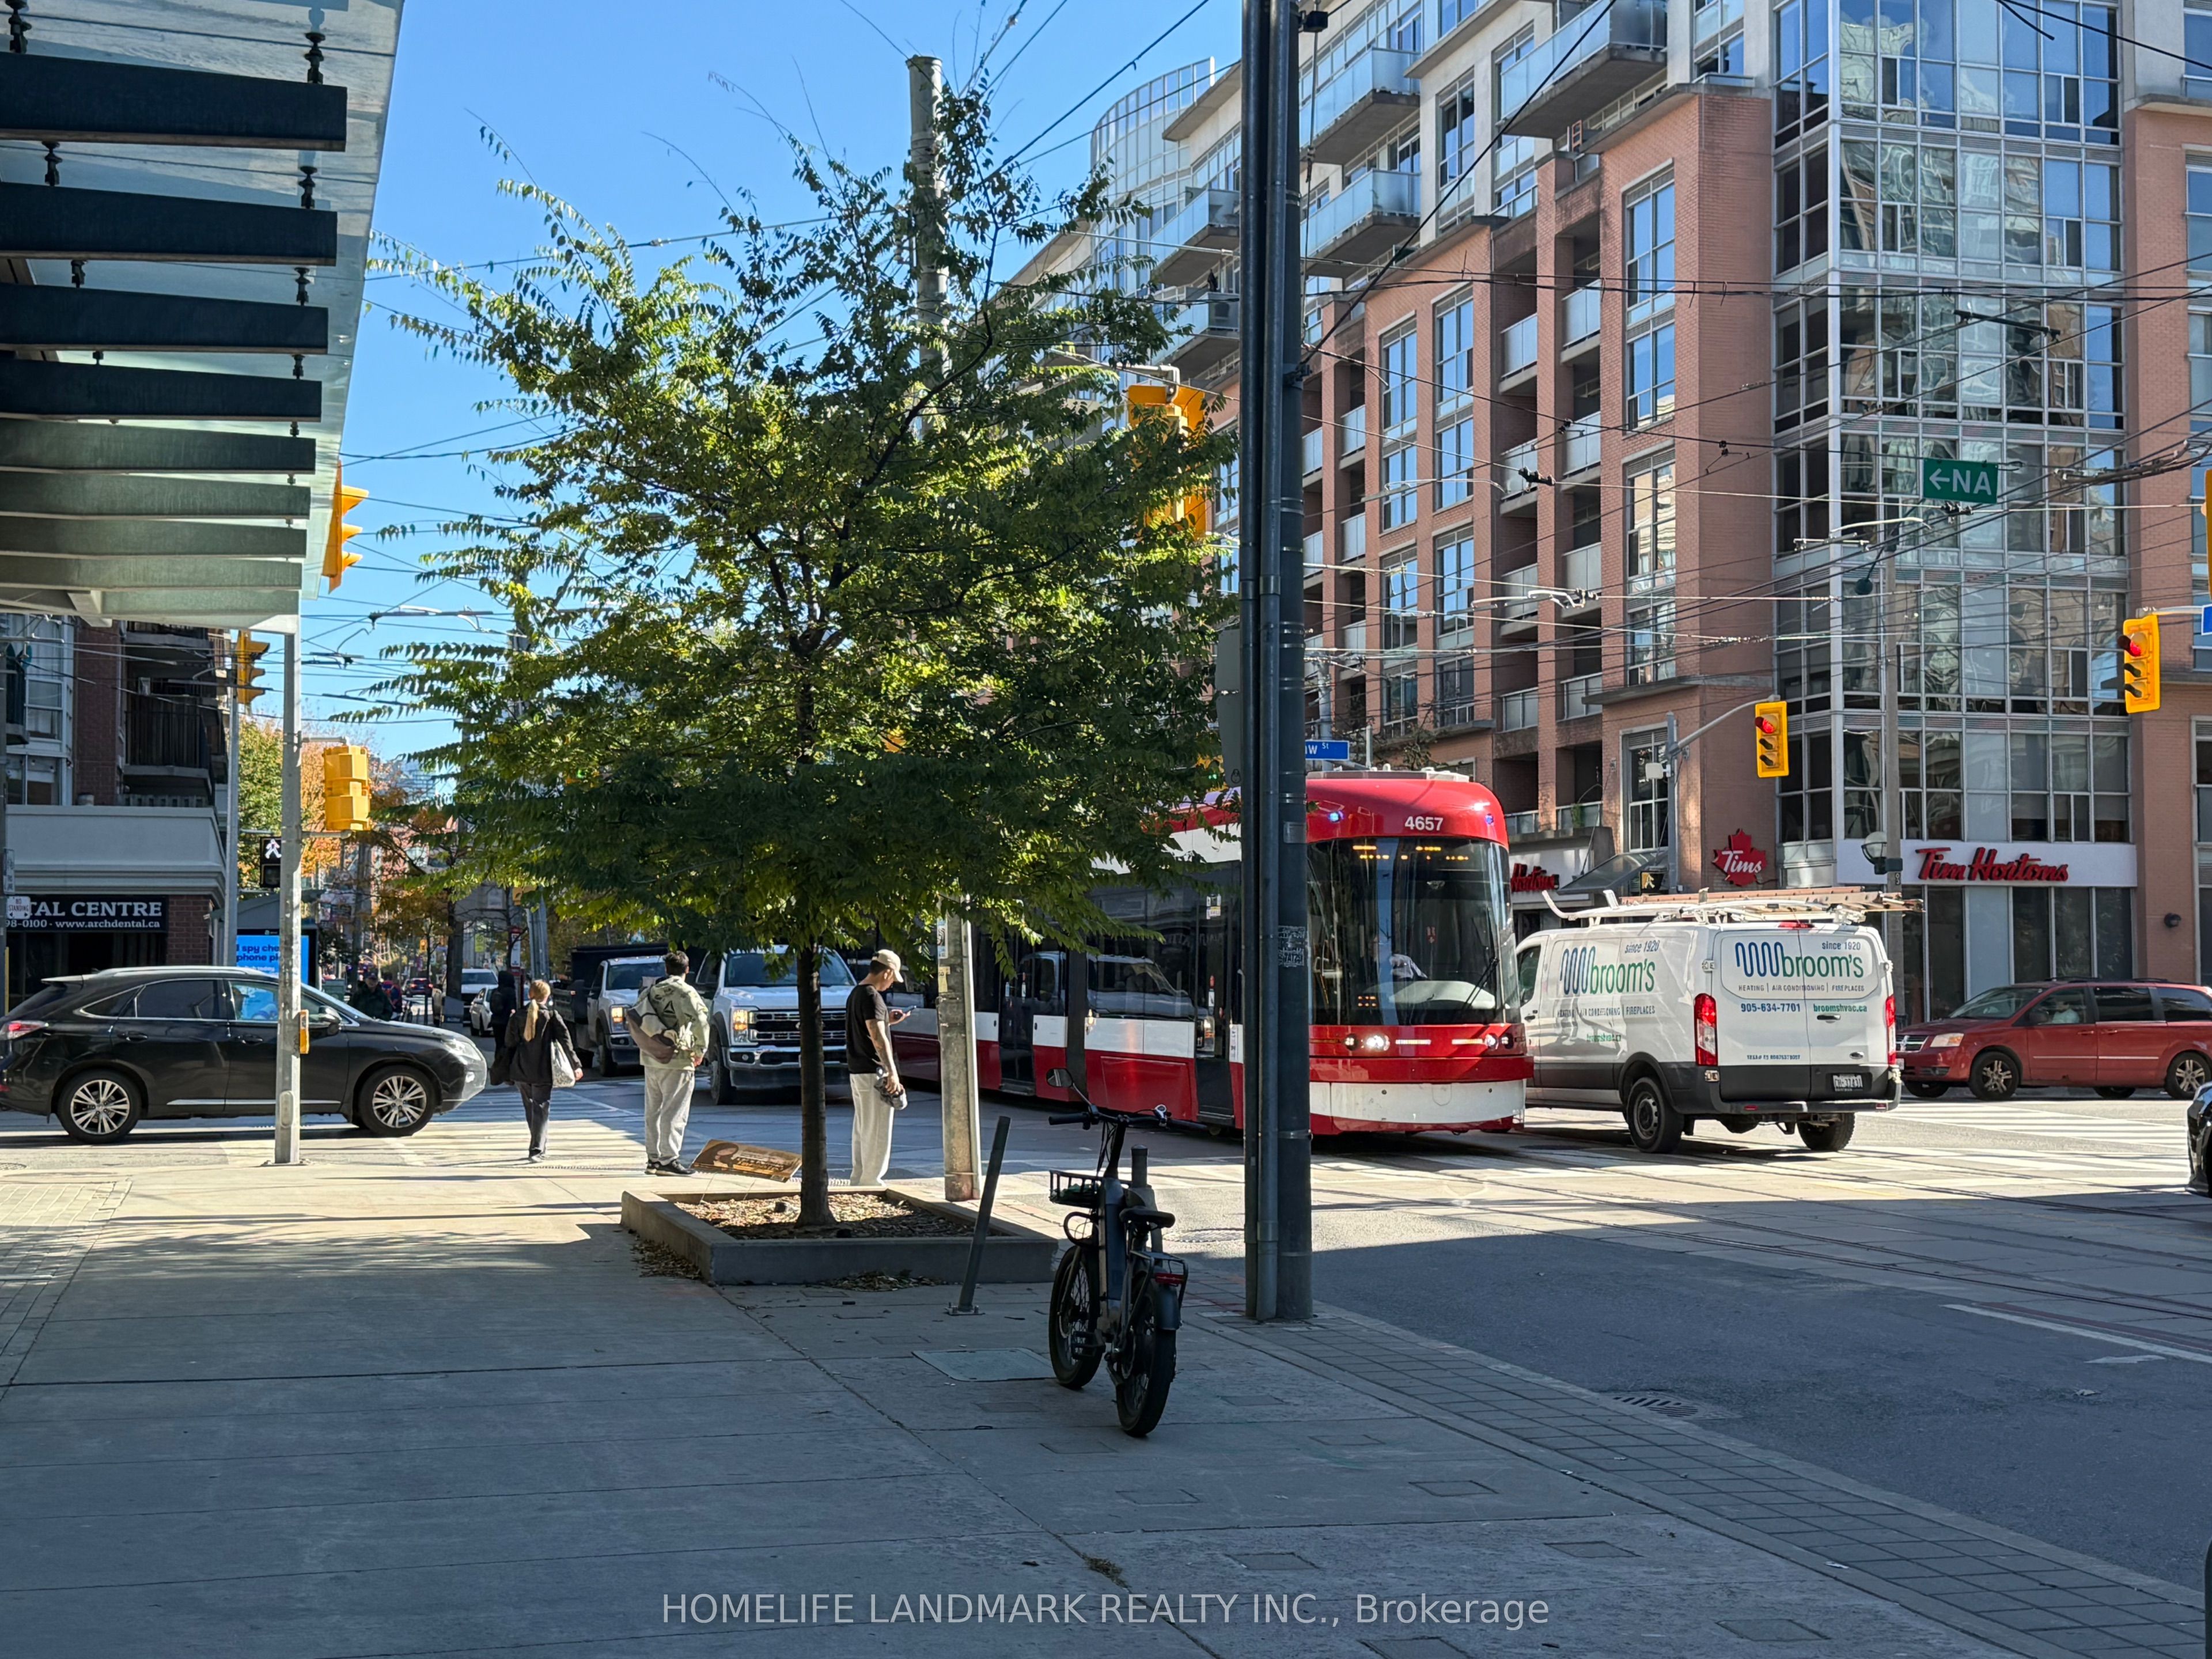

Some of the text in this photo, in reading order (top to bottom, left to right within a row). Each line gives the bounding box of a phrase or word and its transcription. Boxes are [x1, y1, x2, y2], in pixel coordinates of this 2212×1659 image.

[1952, 468, 1992, 495] NA
[1404, 816, 1444, 831] 4657
[1722, 850, 1762, 873] Tims
[1915, 847, 2069, 881] Tim Hortons
[71, 902, 162, 916] CENTRE
[55, 919, 160, 928] www.archdental.ca
[242, 945, 260, 954] spy
[1643, 940, 1660, 953] 1920
[1822, 941, 1861, 950] since 1920
[236, 953, 267, 963] phone
[1783, 954, 1864, 978] broom's
[1590, 958, 1656, 994] broom's
[1741, 1003, 1801, 1012] 905-634-7701
[1813, 1003, 1867, 1013] broomshvac.ca
